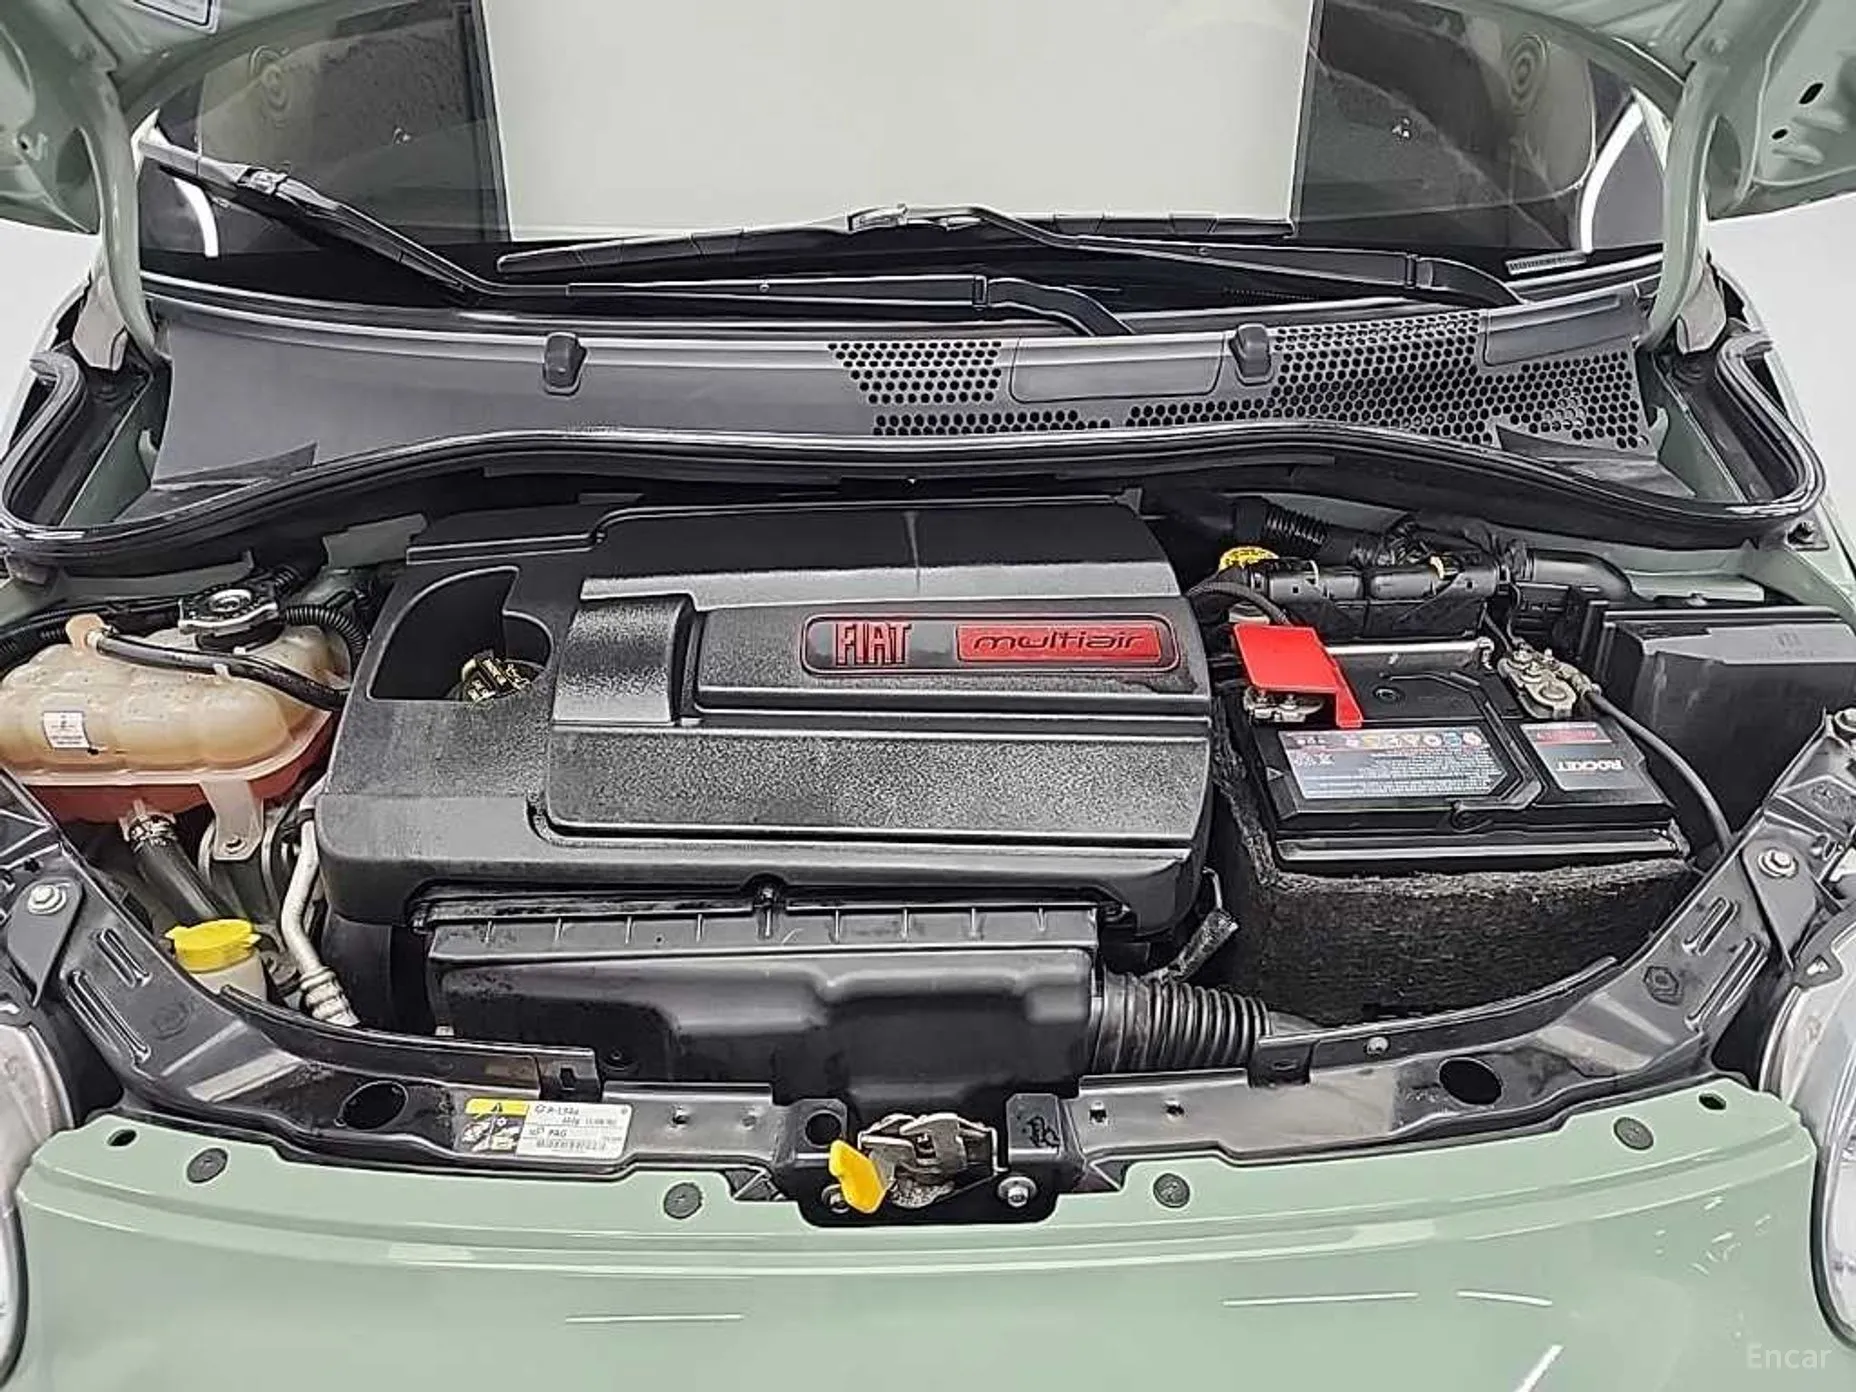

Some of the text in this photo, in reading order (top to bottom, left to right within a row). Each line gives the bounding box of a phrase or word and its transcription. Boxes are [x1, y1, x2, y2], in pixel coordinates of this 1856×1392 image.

[835, 622, 1143, 665] FIAT multiair
[1556, 759, 1625, 772] ROCKET
